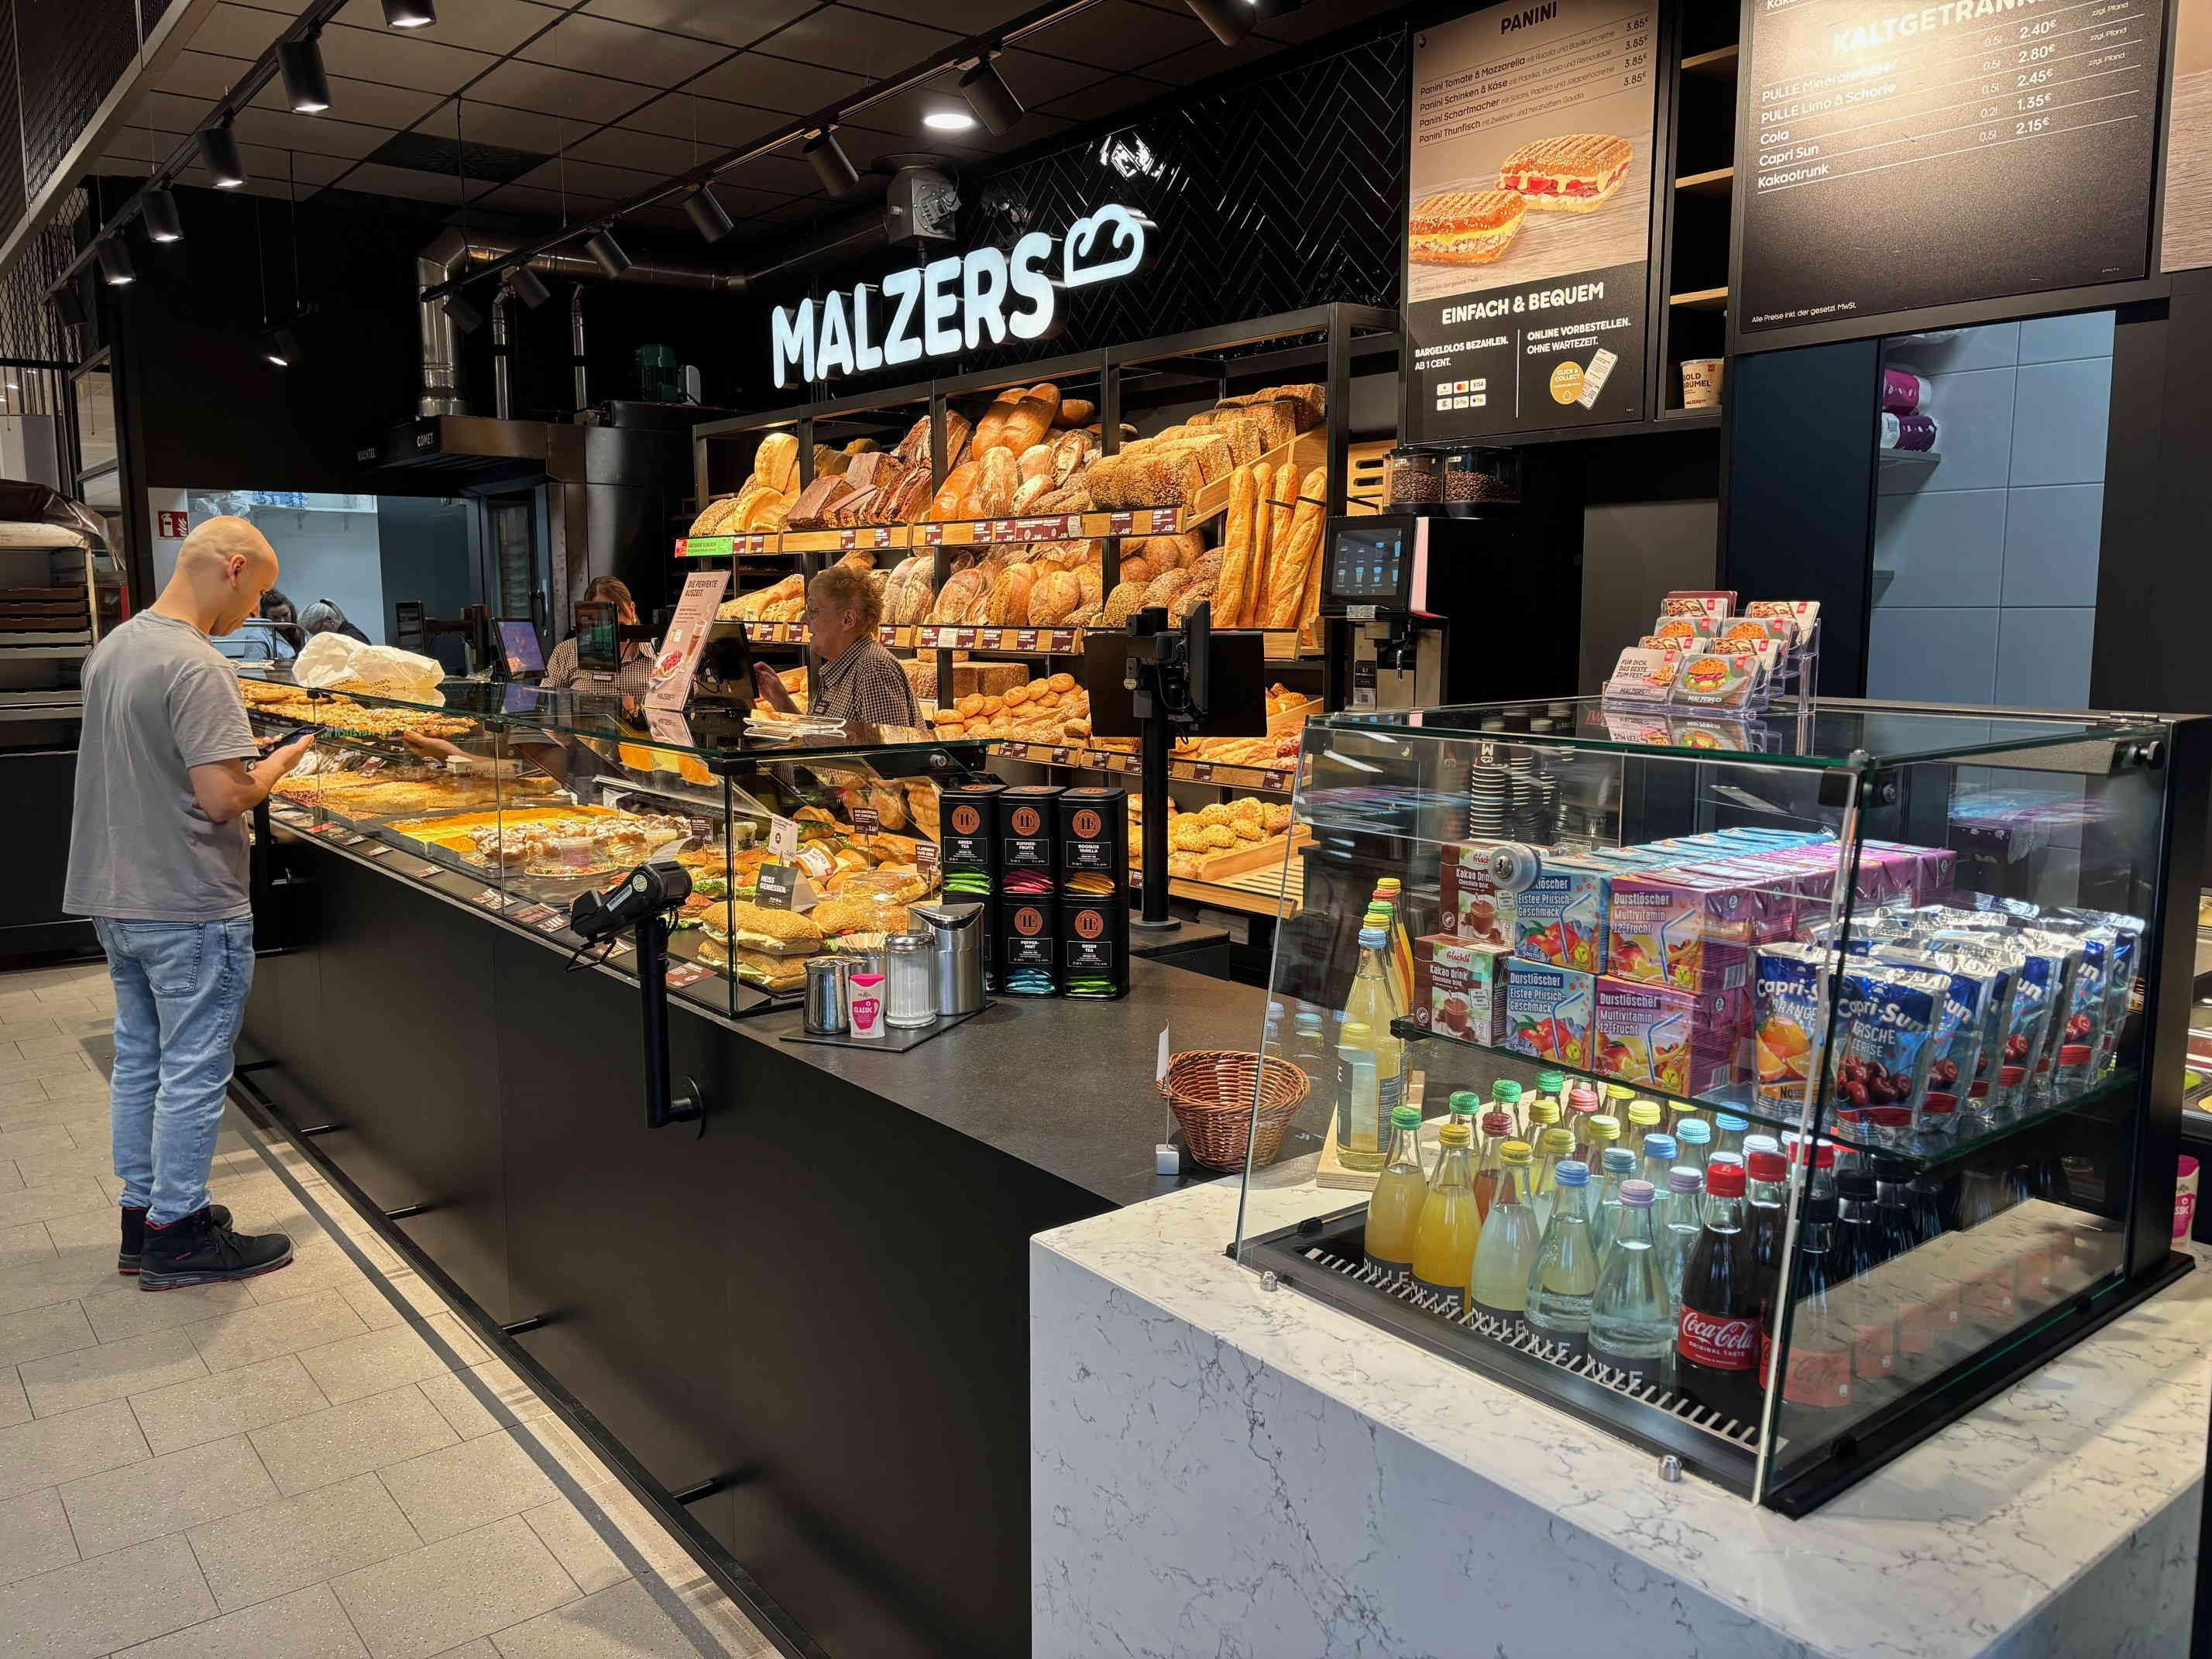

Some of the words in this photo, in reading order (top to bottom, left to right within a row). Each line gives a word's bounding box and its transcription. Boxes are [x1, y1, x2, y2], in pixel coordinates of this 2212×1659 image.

[1500, 2, 1558, 35] PANINI
[1762, 84, 1800, 102] PULLE
[2019, 19, 2057, 40] 2.40€
[1420, 81, 1443, 95] Panini
[1444, 74, 1473, 88] Tomate
[1475, 70, 1480, 79] &
[1482, 57, 1525, 77] Mozzarella
[1760, 105, 1799, 124] PULLE
[1802, 98, 1832, 115] Limo
[1846, 83, 1897, 104] Schorle
[2018, 43, 2056, 64] 2.80€
[1420, 98, 1443, 112] Panini
[1444, 88, 1479, 104] Schinken
[1481, 85, 1486, 94] &
[1488, 80, 1508, 91] Käse
[1760, 130, 1789, 145] Cola
[2017, 68, 2053, 88] 2.45€
[1420, 114, 1443, 128] Panini
[1444, 98, 1500, 120] Scharfmacher
[1419, 129, 1442, 143] Panini
[1444, 120, 1481, 137] Thunfisch
[1759, 147, 1794, 167] Capri
[1796, 144, 1819, 160] Sun
[2017, 93, 2052, 111] 1.35€
[1758, 163, 1829, 189] Kakaotrunk
[2015, 117, 2051, 136] 2.15€
[771, 232, 1055, 389] MALZERS
[1442, 297, 1509, 325] EINFACH
[1513, 295, 1525, 313] &
[1528, 282, 1604, 311] BEQUEM
[1527, 328, 1559, 341] ONLINE
[1560, 317, 1631, 336] VORBESTELLEN.
[1764, 313, 1784, 322] Preise
[1415, 342, 1465, 358] BARGELDLOS
[1465, 335, 1509, 350] BEZAHLEN.
[1527, 342, 1551, 355] OHNE
[1551, 336, 1599, 352] WARTEZEIT.
[1414, 361, 1425, 371] AB
[1431, 357, 1451, 369] CENT.
[1456, 868, 1476, 881] Kakao
[1477, 871, 1492, 882] Drin
[1518, 894, 1541, 905] Eistee
[1614, 891, 1670, 905] Durstlöscher
[1518, 906, 1561, 918] Geschmack
[1614, 908, 1666, 921] Multivitamin
[1430, 964, 1450, 976] Kakao
[1451, 968, 1468, 980] Drink
[1510, 972, 1561, 987] Durstlöscher
[1510, 988, 1534, 998] Eistee
[1600, 992, 1657, 1008] Durstlöscher
[1757, 978, 1819, 1001] Capri-S
[1510, 1001, 1552, 1013] Geschmack
[1599, 1009, 1653, 1023] Multivitamin
[1837, 997, 1923, 1033] Capri-Sun
[1599, 1022, 1638, 1036] 12-Frucht
[1683, 1312, 1753, 1349] Coca-Cola
[1688, 1340, 1721, 1355] ORIGINAL
